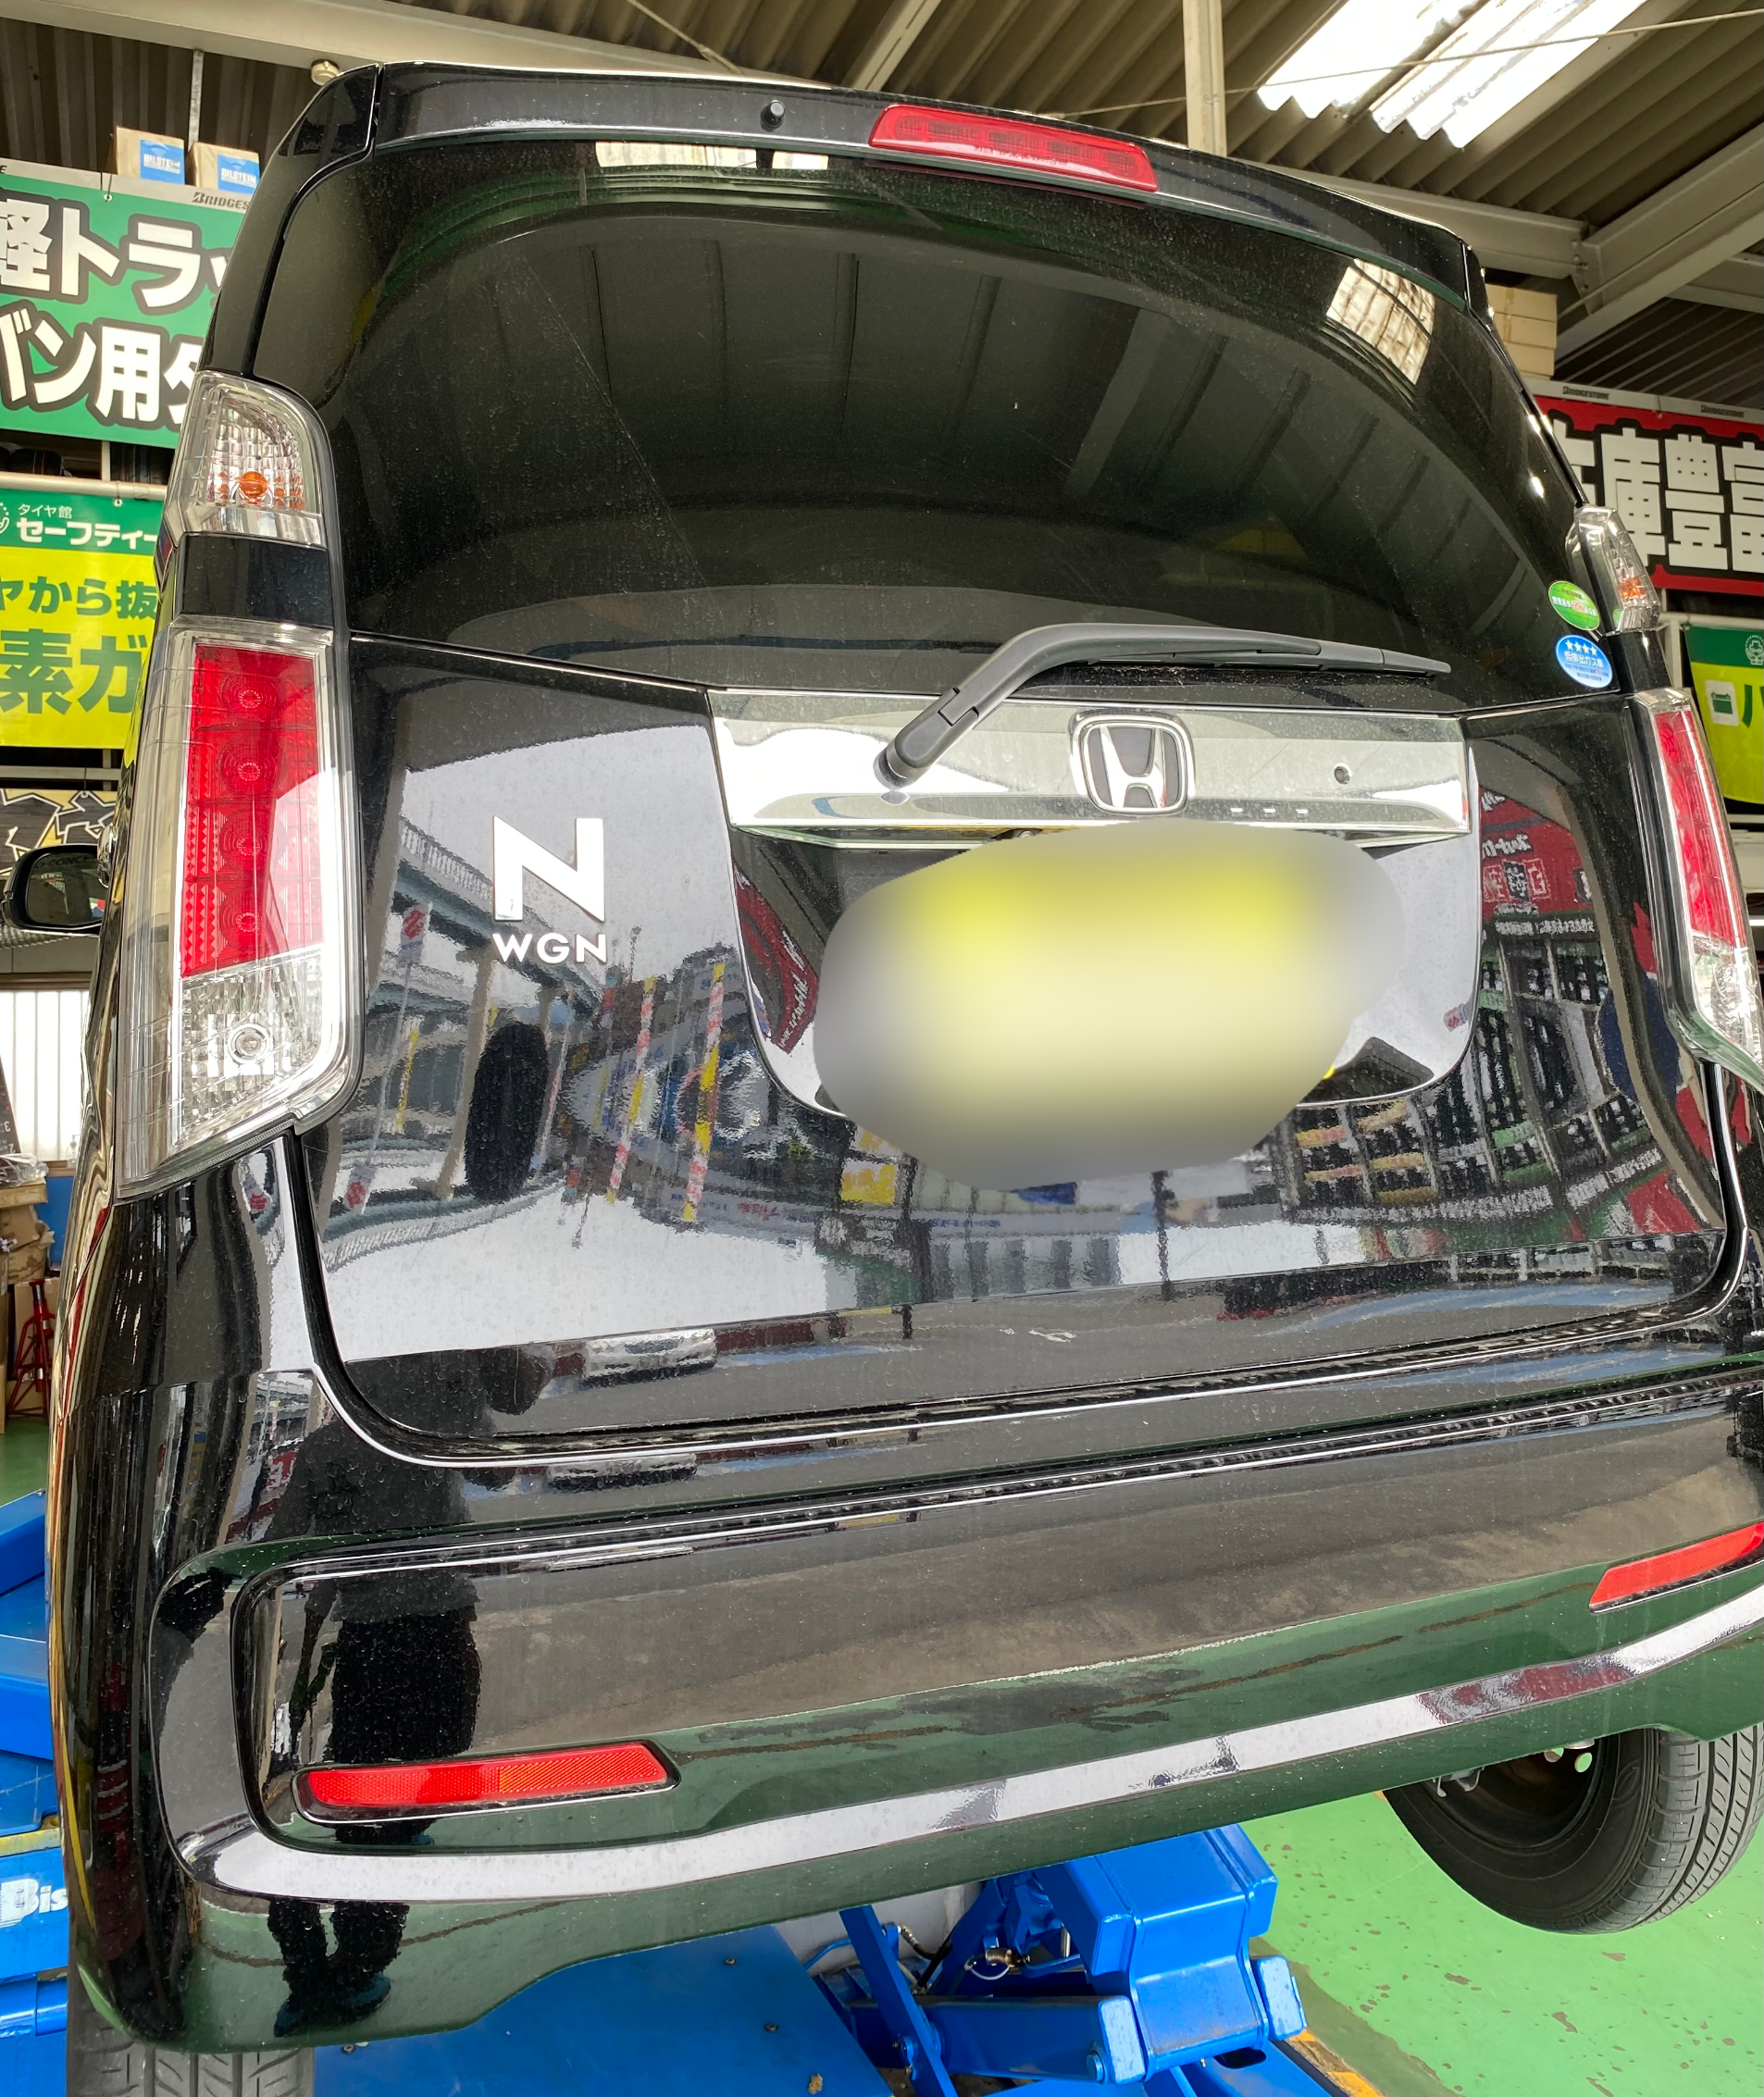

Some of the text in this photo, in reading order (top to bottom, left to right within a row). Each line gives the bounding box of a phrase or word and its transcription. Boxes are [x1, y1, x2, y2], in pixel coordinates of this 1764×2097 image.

[143, 154, 180, 170] BILSTEIN
[221, 168, 257, 184] BILSTEIN
[192, 192, 250, 210] BRIDGES
[0, 198, 228, 308] 軽トラ
[1562, 386, 1610, 401] BRIDGESTONE
[1700, 404, 1745, 418] BRIDGESTONE
[18, 503, 73, 519] タイヤ館
[492, 815, 605, 923] N
[491, 933, 608, 964] WGN
